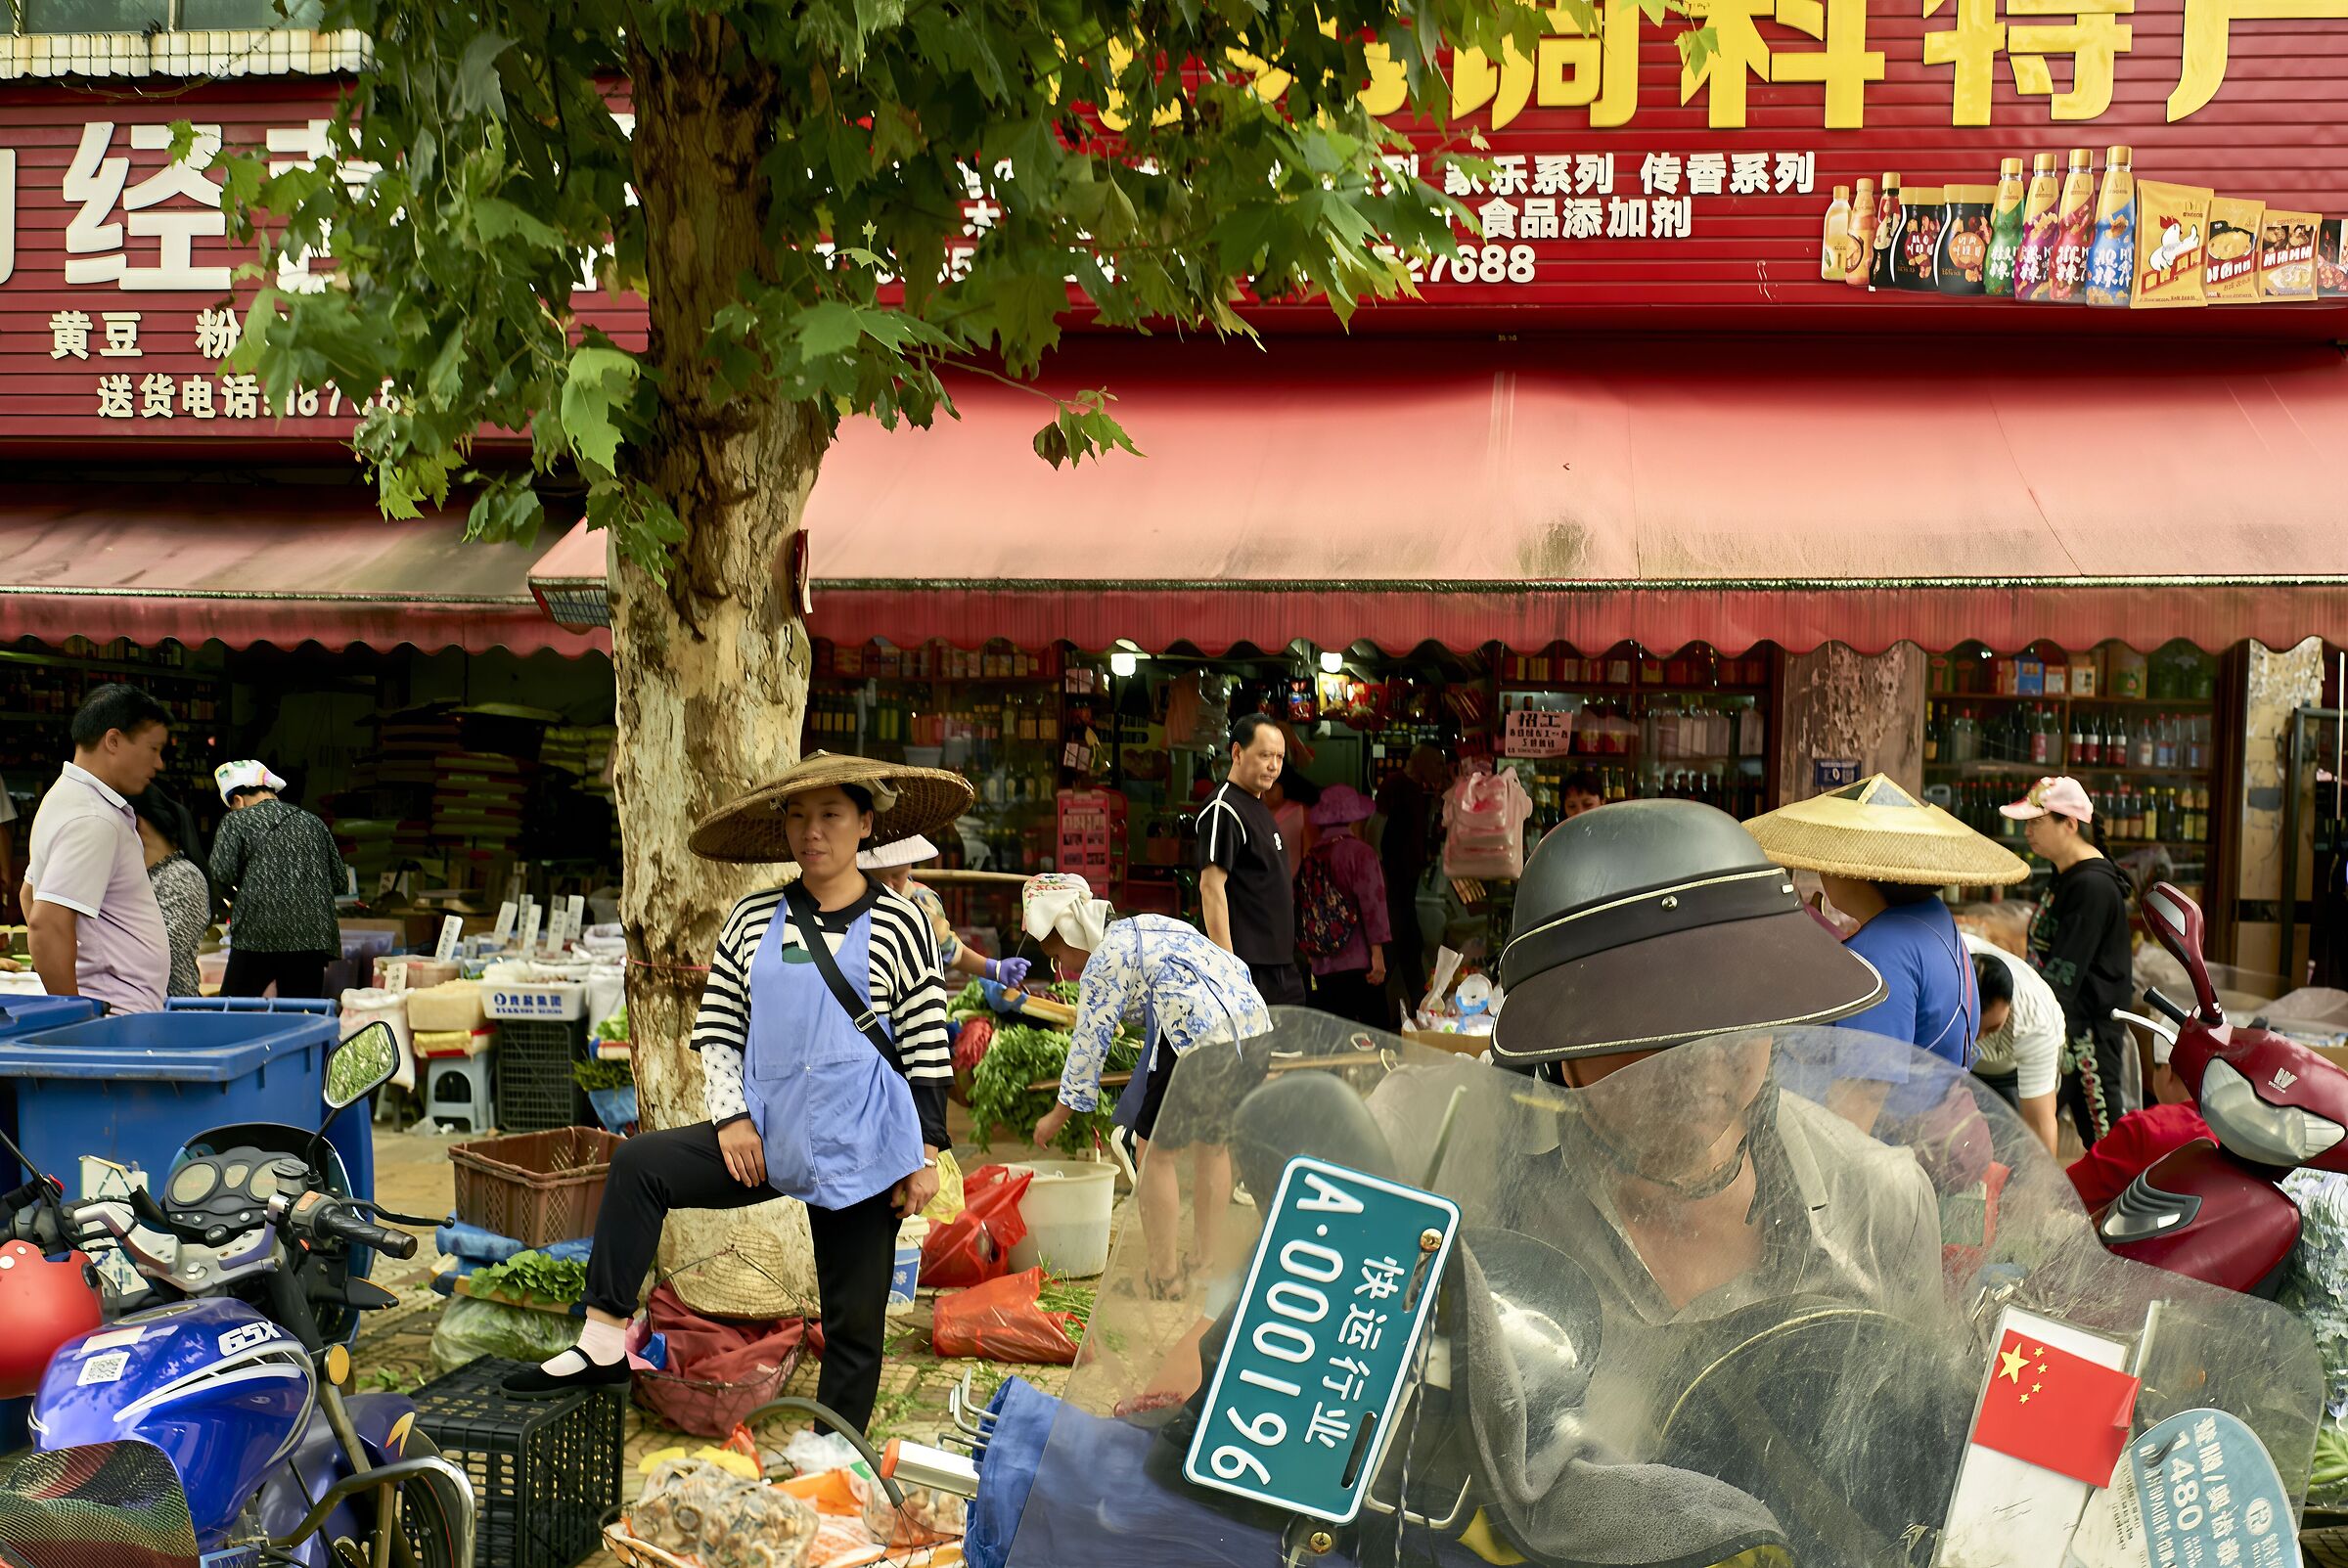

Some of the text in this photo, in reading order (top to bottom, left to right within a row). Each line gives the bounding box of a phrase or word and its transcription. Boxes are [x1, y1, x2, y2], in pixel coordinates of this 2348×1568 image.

[1640, 151, 1816, 196] 传香系列
[1478, 196, 1692, 239] 食品添加剂
[49, 309, 143, 360] 黄豆
[218, 1321, 282, 1357] GSX
[1304, 1256, 1405, 1449] 快运行业
